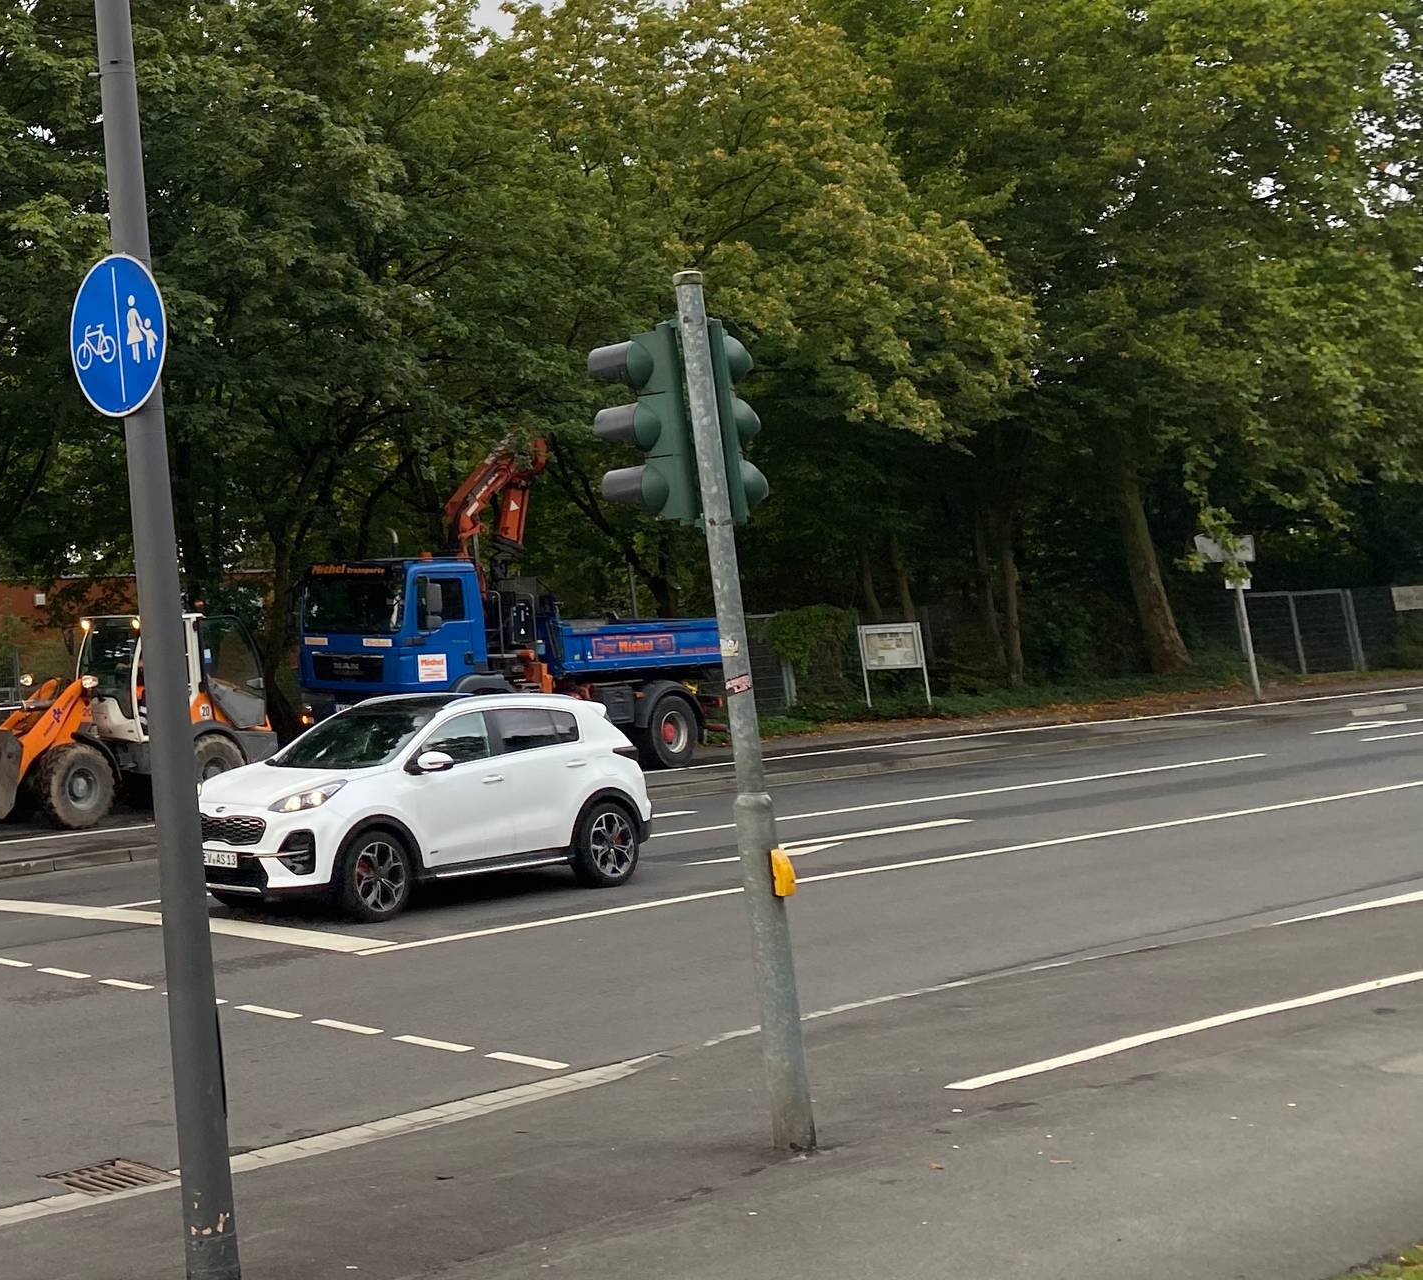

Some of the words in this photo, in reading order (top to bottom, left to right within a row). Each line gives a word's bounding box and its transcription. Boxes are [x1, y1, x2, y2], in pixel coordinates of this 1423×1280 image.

[312, 563, 345, 575] Michel
[619, 640, 653, 652] Michel
[420, 658, 444, 666] Michel
[201, 706, 209, 716] 20
[217, 853, 225, 865] AS
[227, 854, 236, 866] 13
